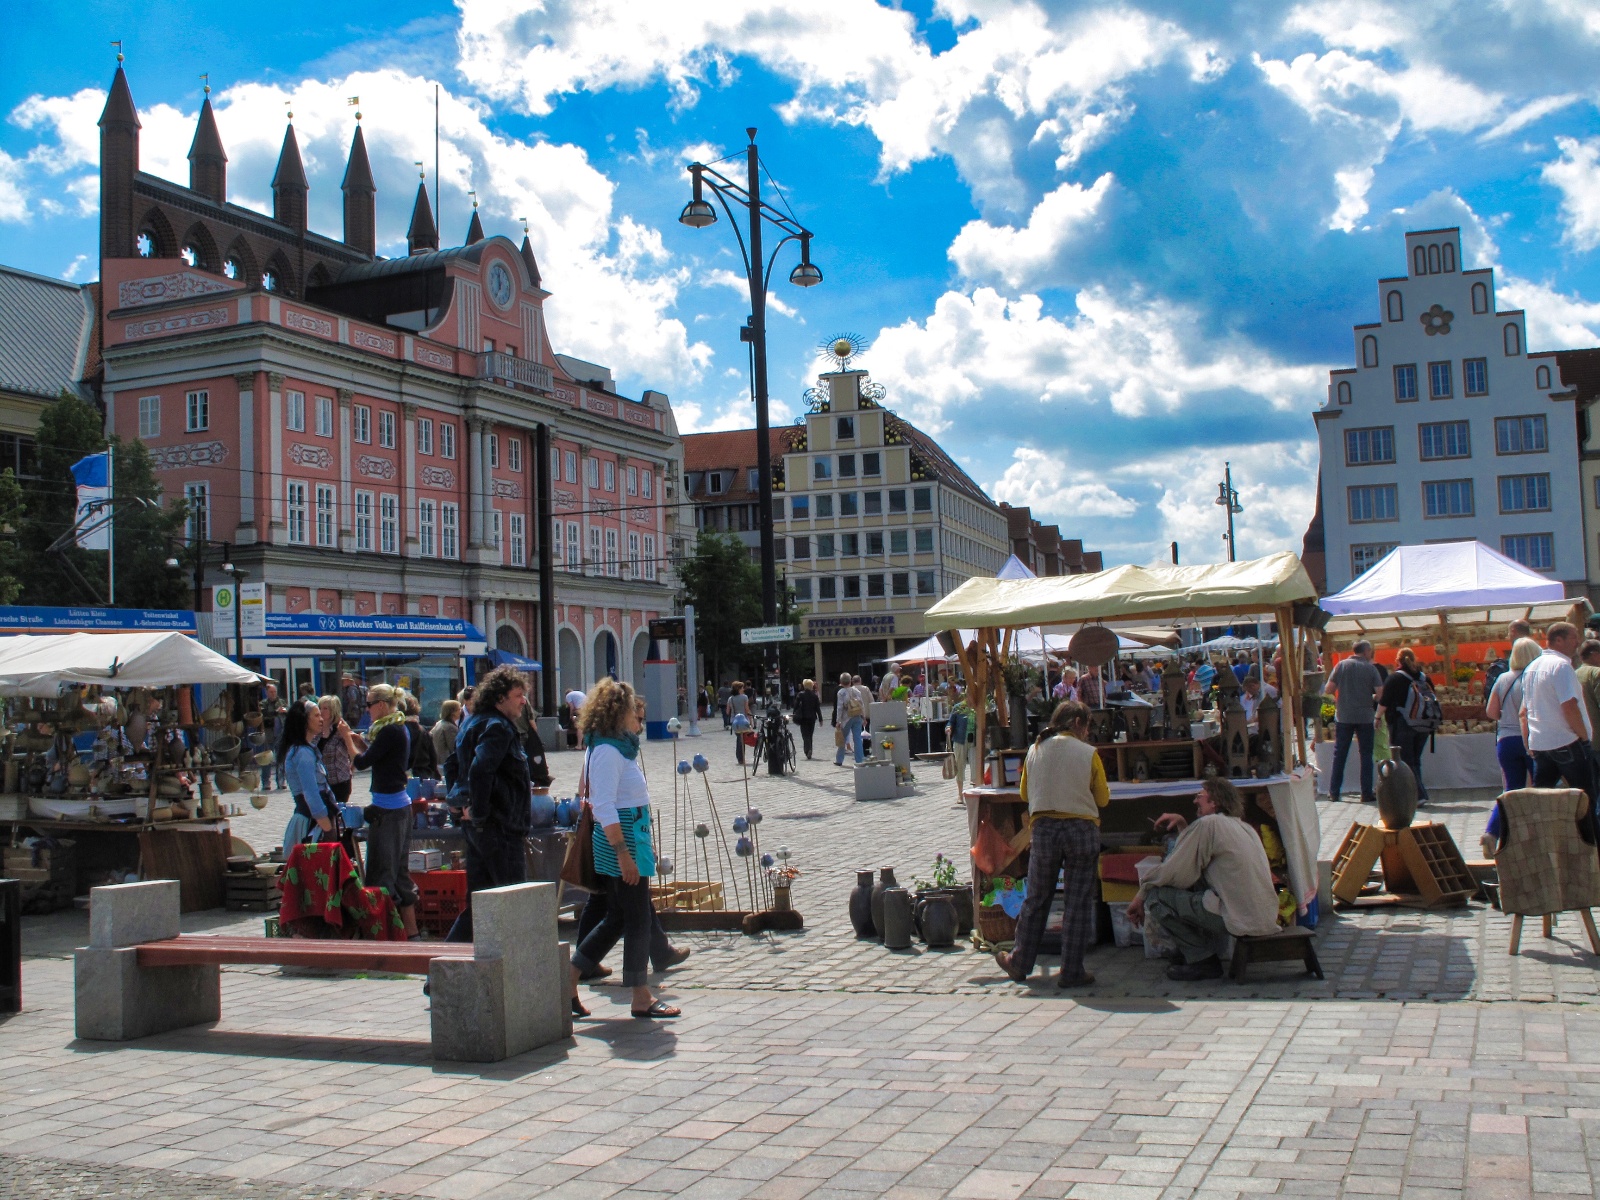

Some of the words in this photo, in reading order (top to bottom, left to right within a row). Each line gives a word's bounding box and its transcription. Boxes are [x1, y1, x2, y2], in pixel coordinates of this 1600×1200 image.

[20, 616, 44, 624] Straße
[338, 619, 373, 629] Rostocker
[374, 620, 395, 630] Volks-
[396, 621, 408, 630] und
[409, 621, 454, 631] Raiffeisenbank
[808, 615, 895, 628] STEIGENBERGER
[808, 628, 850, 637] HOTEL
[854, 625, 896, 635] SONNE
